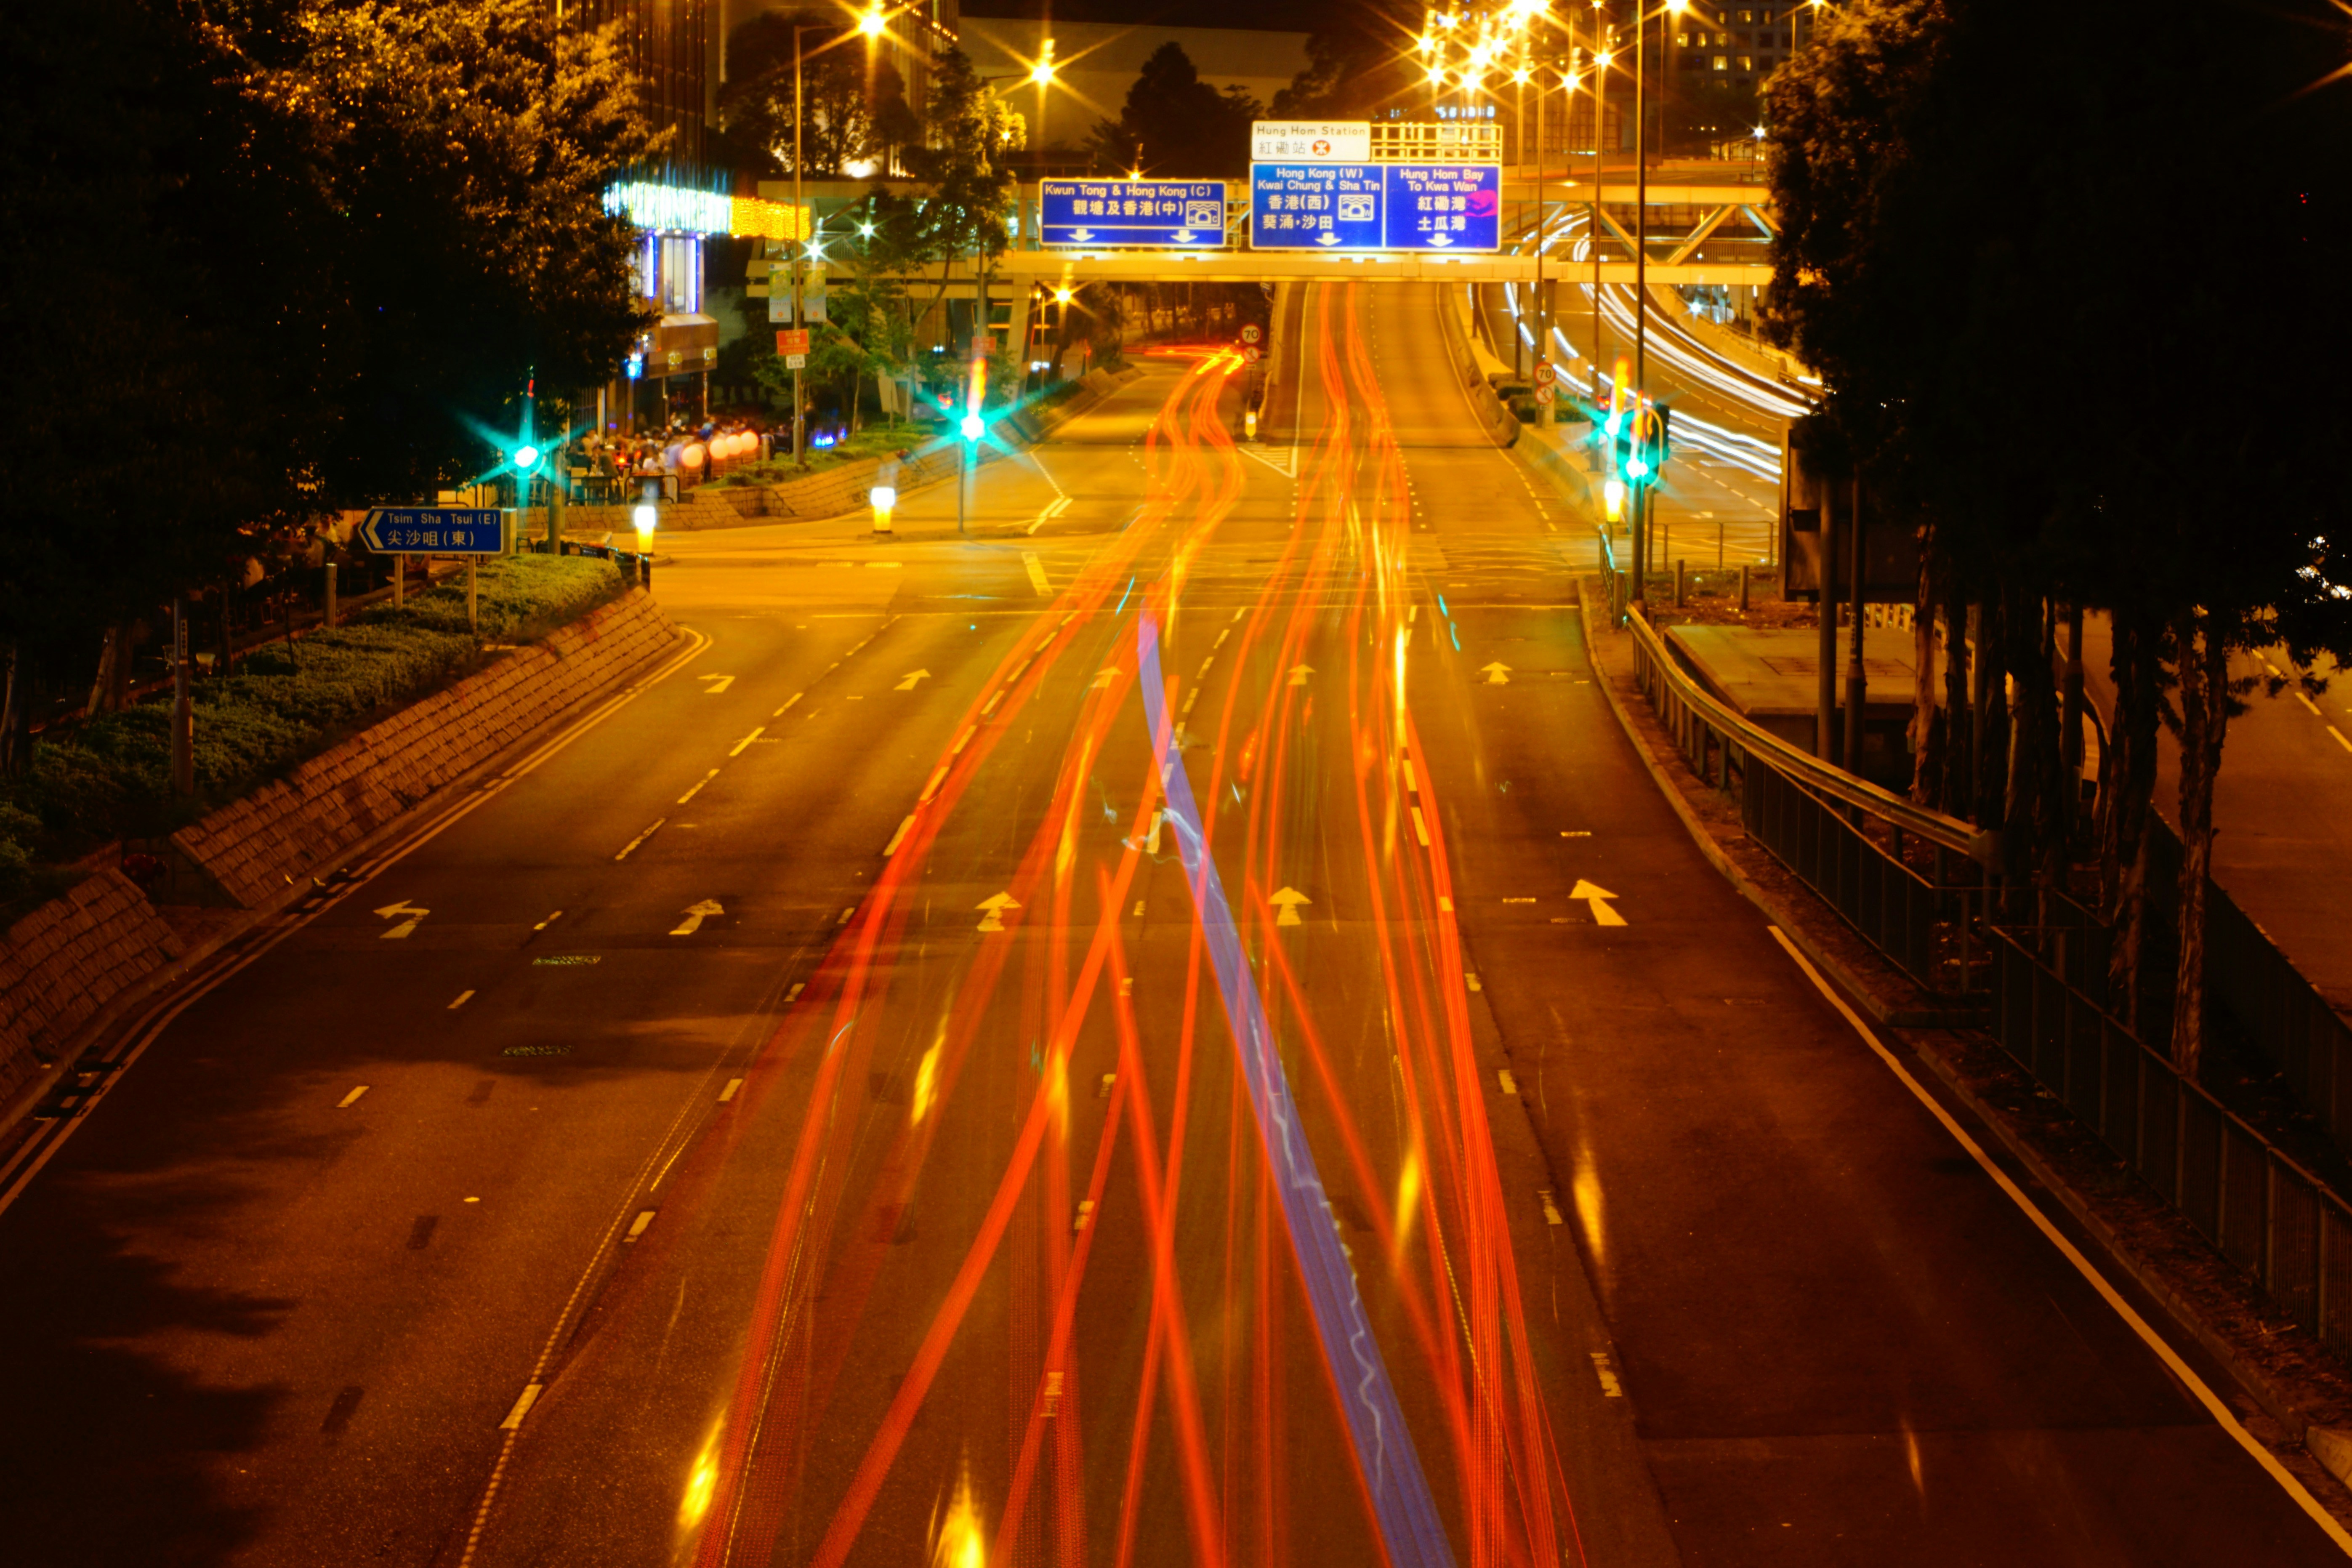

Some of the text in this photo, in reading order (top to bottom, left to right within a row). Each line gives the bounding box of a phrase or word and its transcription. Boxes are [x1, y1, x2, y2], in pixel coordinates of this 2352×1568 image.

[1257, 126, 1365, 136] Hung Hom Station
[1259, 141, 1305, 154] 紅磡站
[1277, 168, 1363, 180] Hong Kong (W)
[1400, 169, 1484, 181] Hung Hom Bay
[1045, 185, 1211, 198] Kwun Tong & Hong Kong (C)
[1258, 180, 1380, 192] Kwai Chung & Sha Tin
[1408, 181, 1477, 191] To Kwa Wan
[1269, 194, 1329, 210] 香港(西)
[1418, 196, 1466, 210] 紅磡灣
[1418, 216, 1466, 231] 土瓜灣
[1244, 330, 1259, 339] 70
[1539, 369, 1551, 378] 70
[388, 513, 496, 525] Tsim Sha Tsui (E)
[387, 529, 474, 546] 尖沙咀(東)
